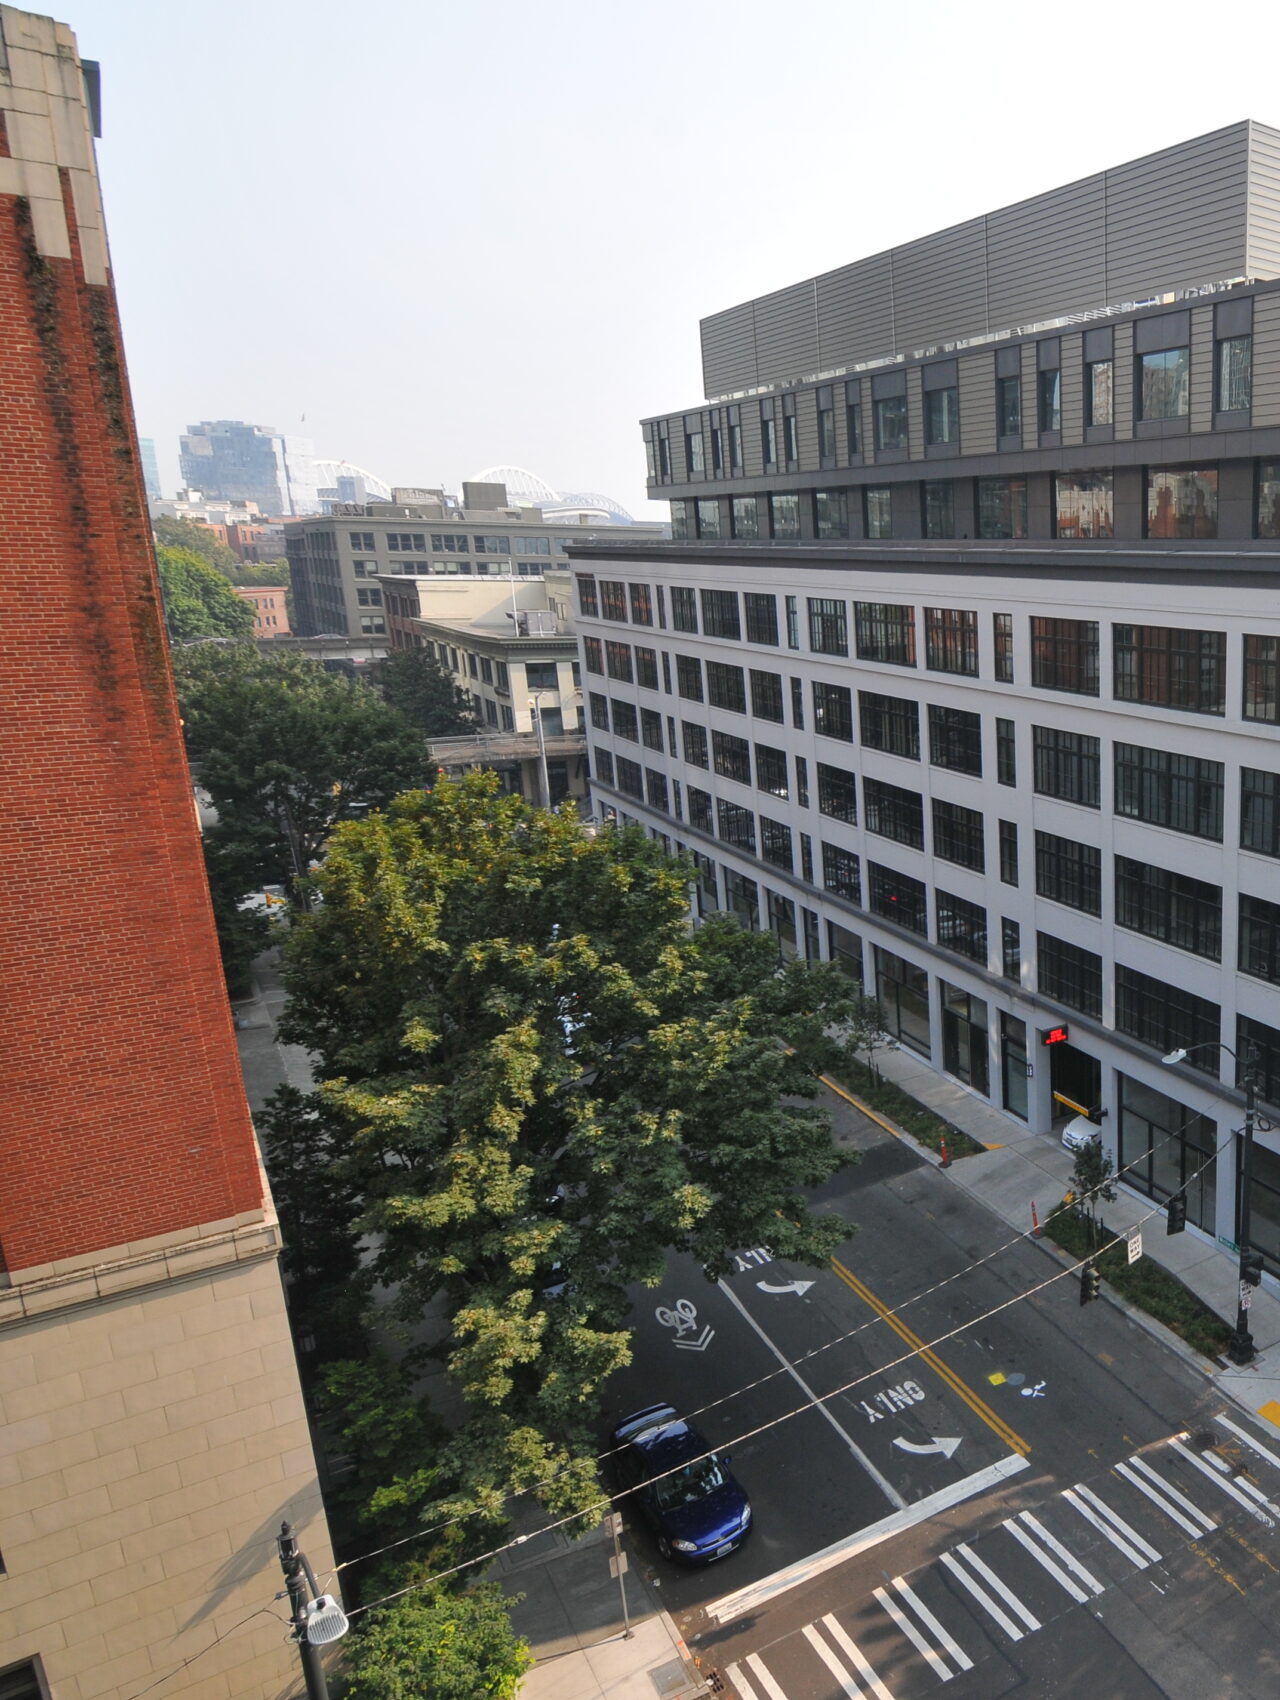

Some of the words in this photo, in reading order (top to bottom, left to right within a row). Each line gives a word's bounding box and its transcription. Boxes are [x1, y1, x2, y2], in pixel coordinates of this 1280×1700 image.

[1129, 1240, 1140, 1248] ONE
[1130, 1245, 1141, 1254] WAY
[735, 1246, 775, 1271] NLY
[860, 1380, 926, 1423] ONLY
